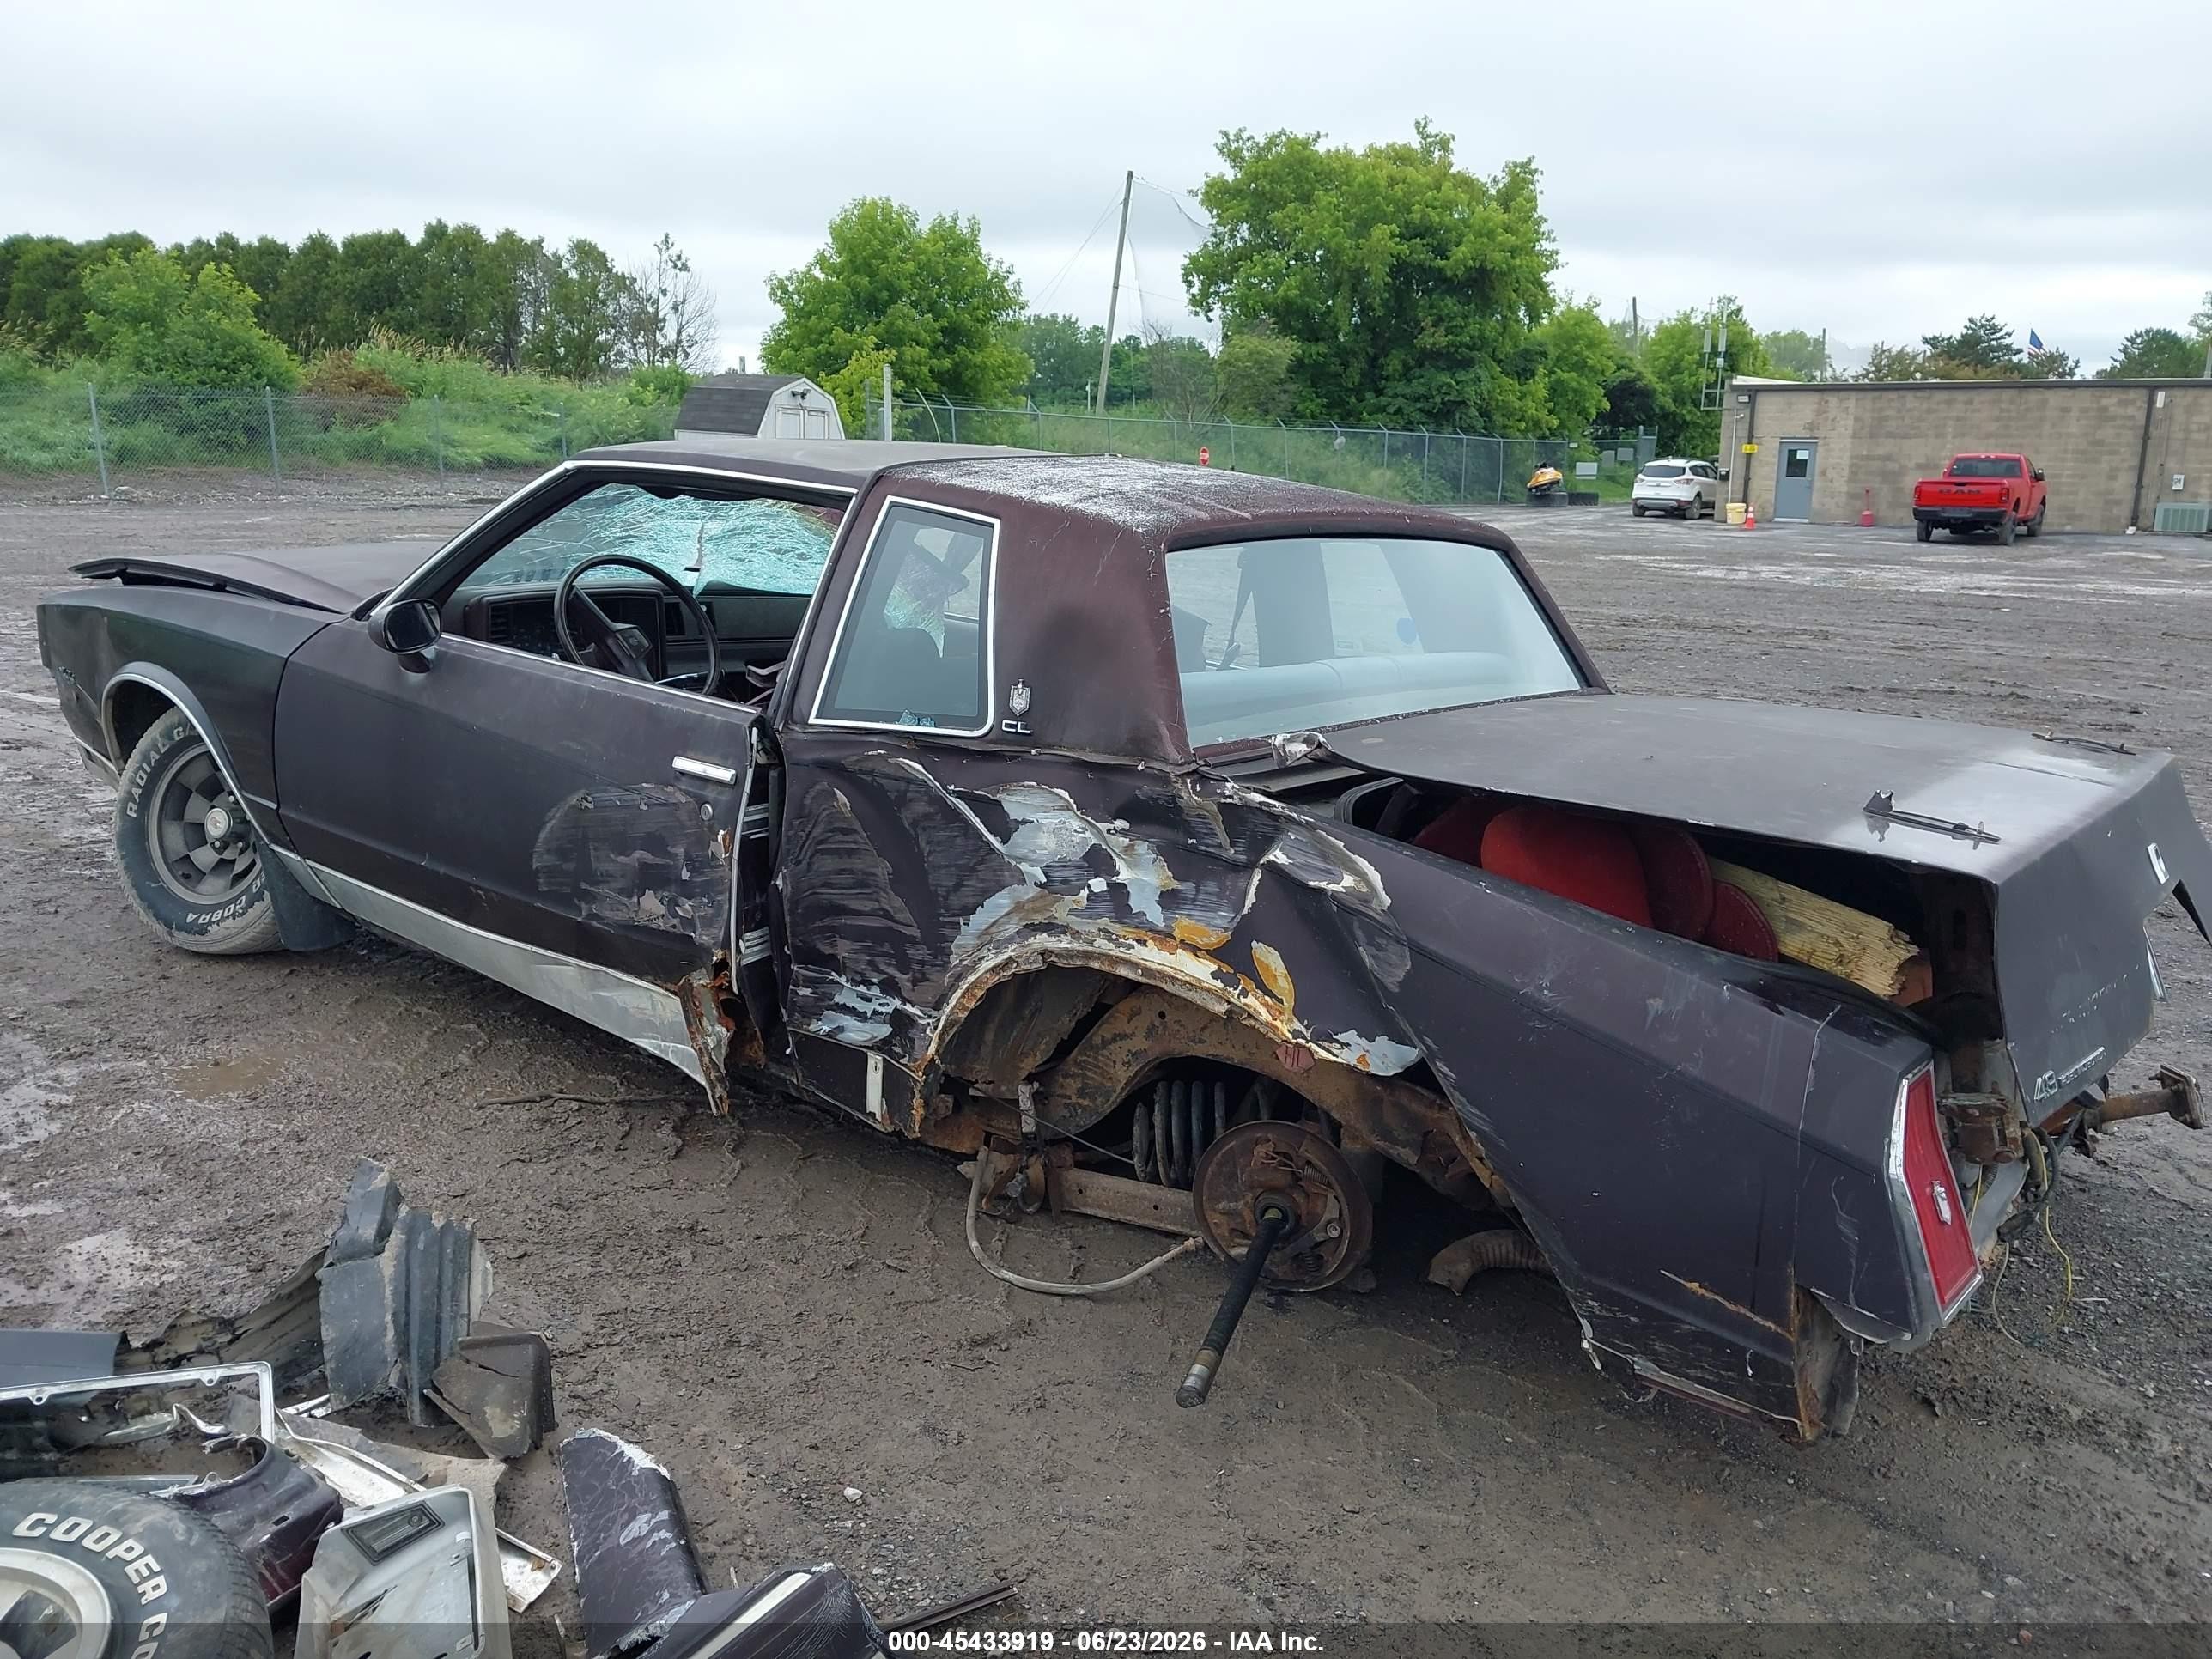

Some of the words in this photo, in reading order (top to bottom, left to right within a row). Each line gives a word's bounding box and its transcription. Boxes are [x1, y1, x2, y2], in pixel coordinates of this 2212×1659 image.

[125, 739, 170, 818] RADIAL
[185, 895, 246, 925] COBRA
[12, 1512, 168, 1606] COOPER
